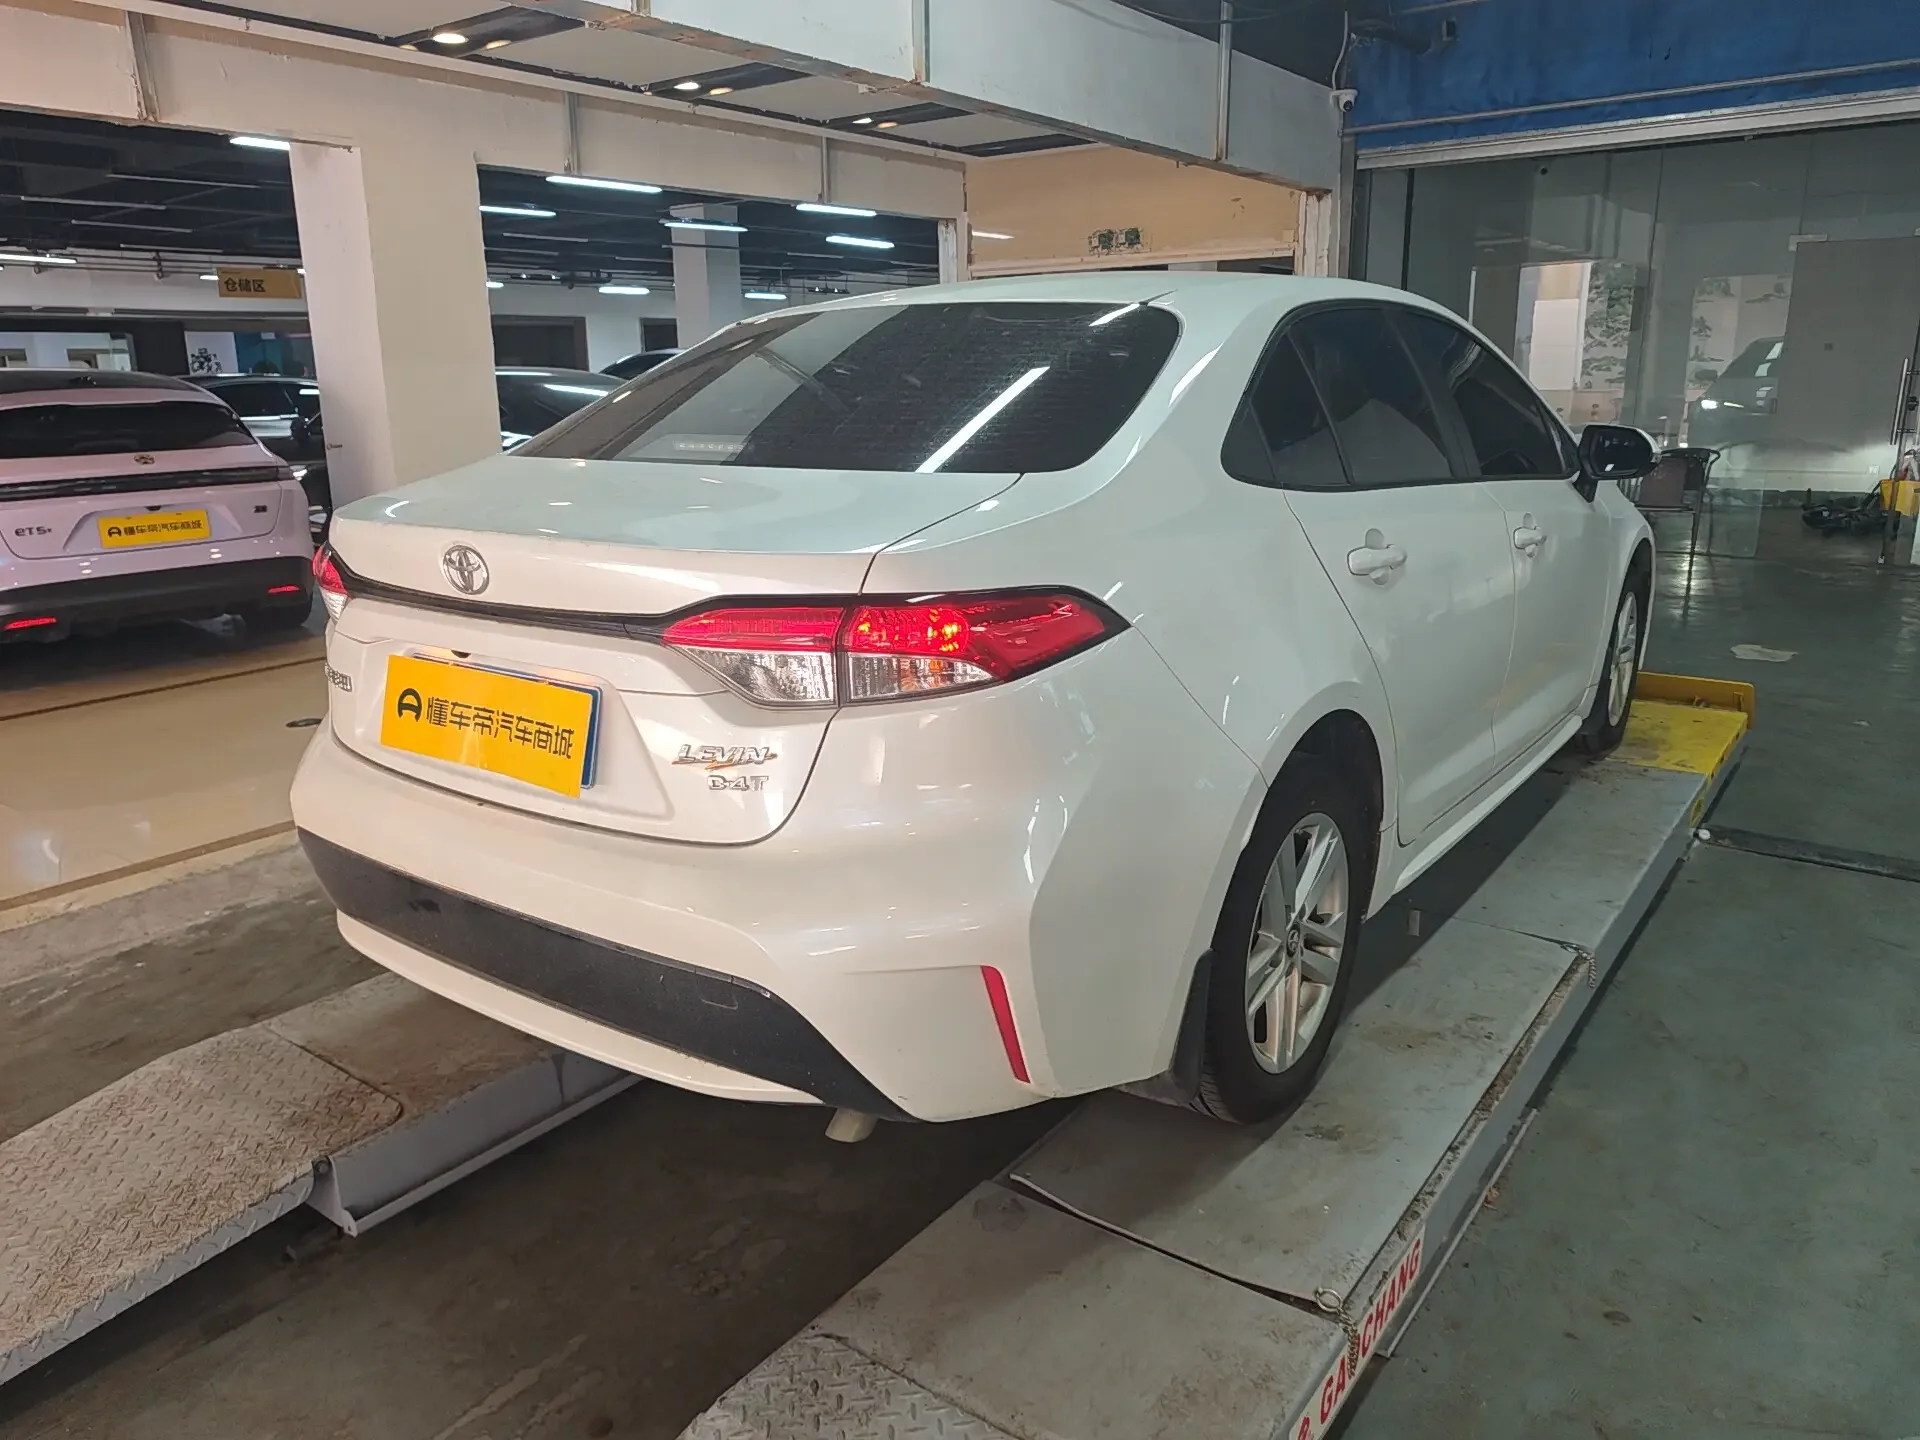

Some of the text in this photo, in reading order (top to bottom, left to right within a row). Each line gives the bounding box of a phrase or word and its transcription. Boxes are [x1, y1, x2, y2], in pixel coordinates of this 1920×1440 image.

[224, 277, 266, 293] 仓储区
[426, 696, 576, 760] 懂车帝汽车商城
[678, 743, 770, 766] LEVIN
[1319, 1238, 1421, 1425] GACHANG
